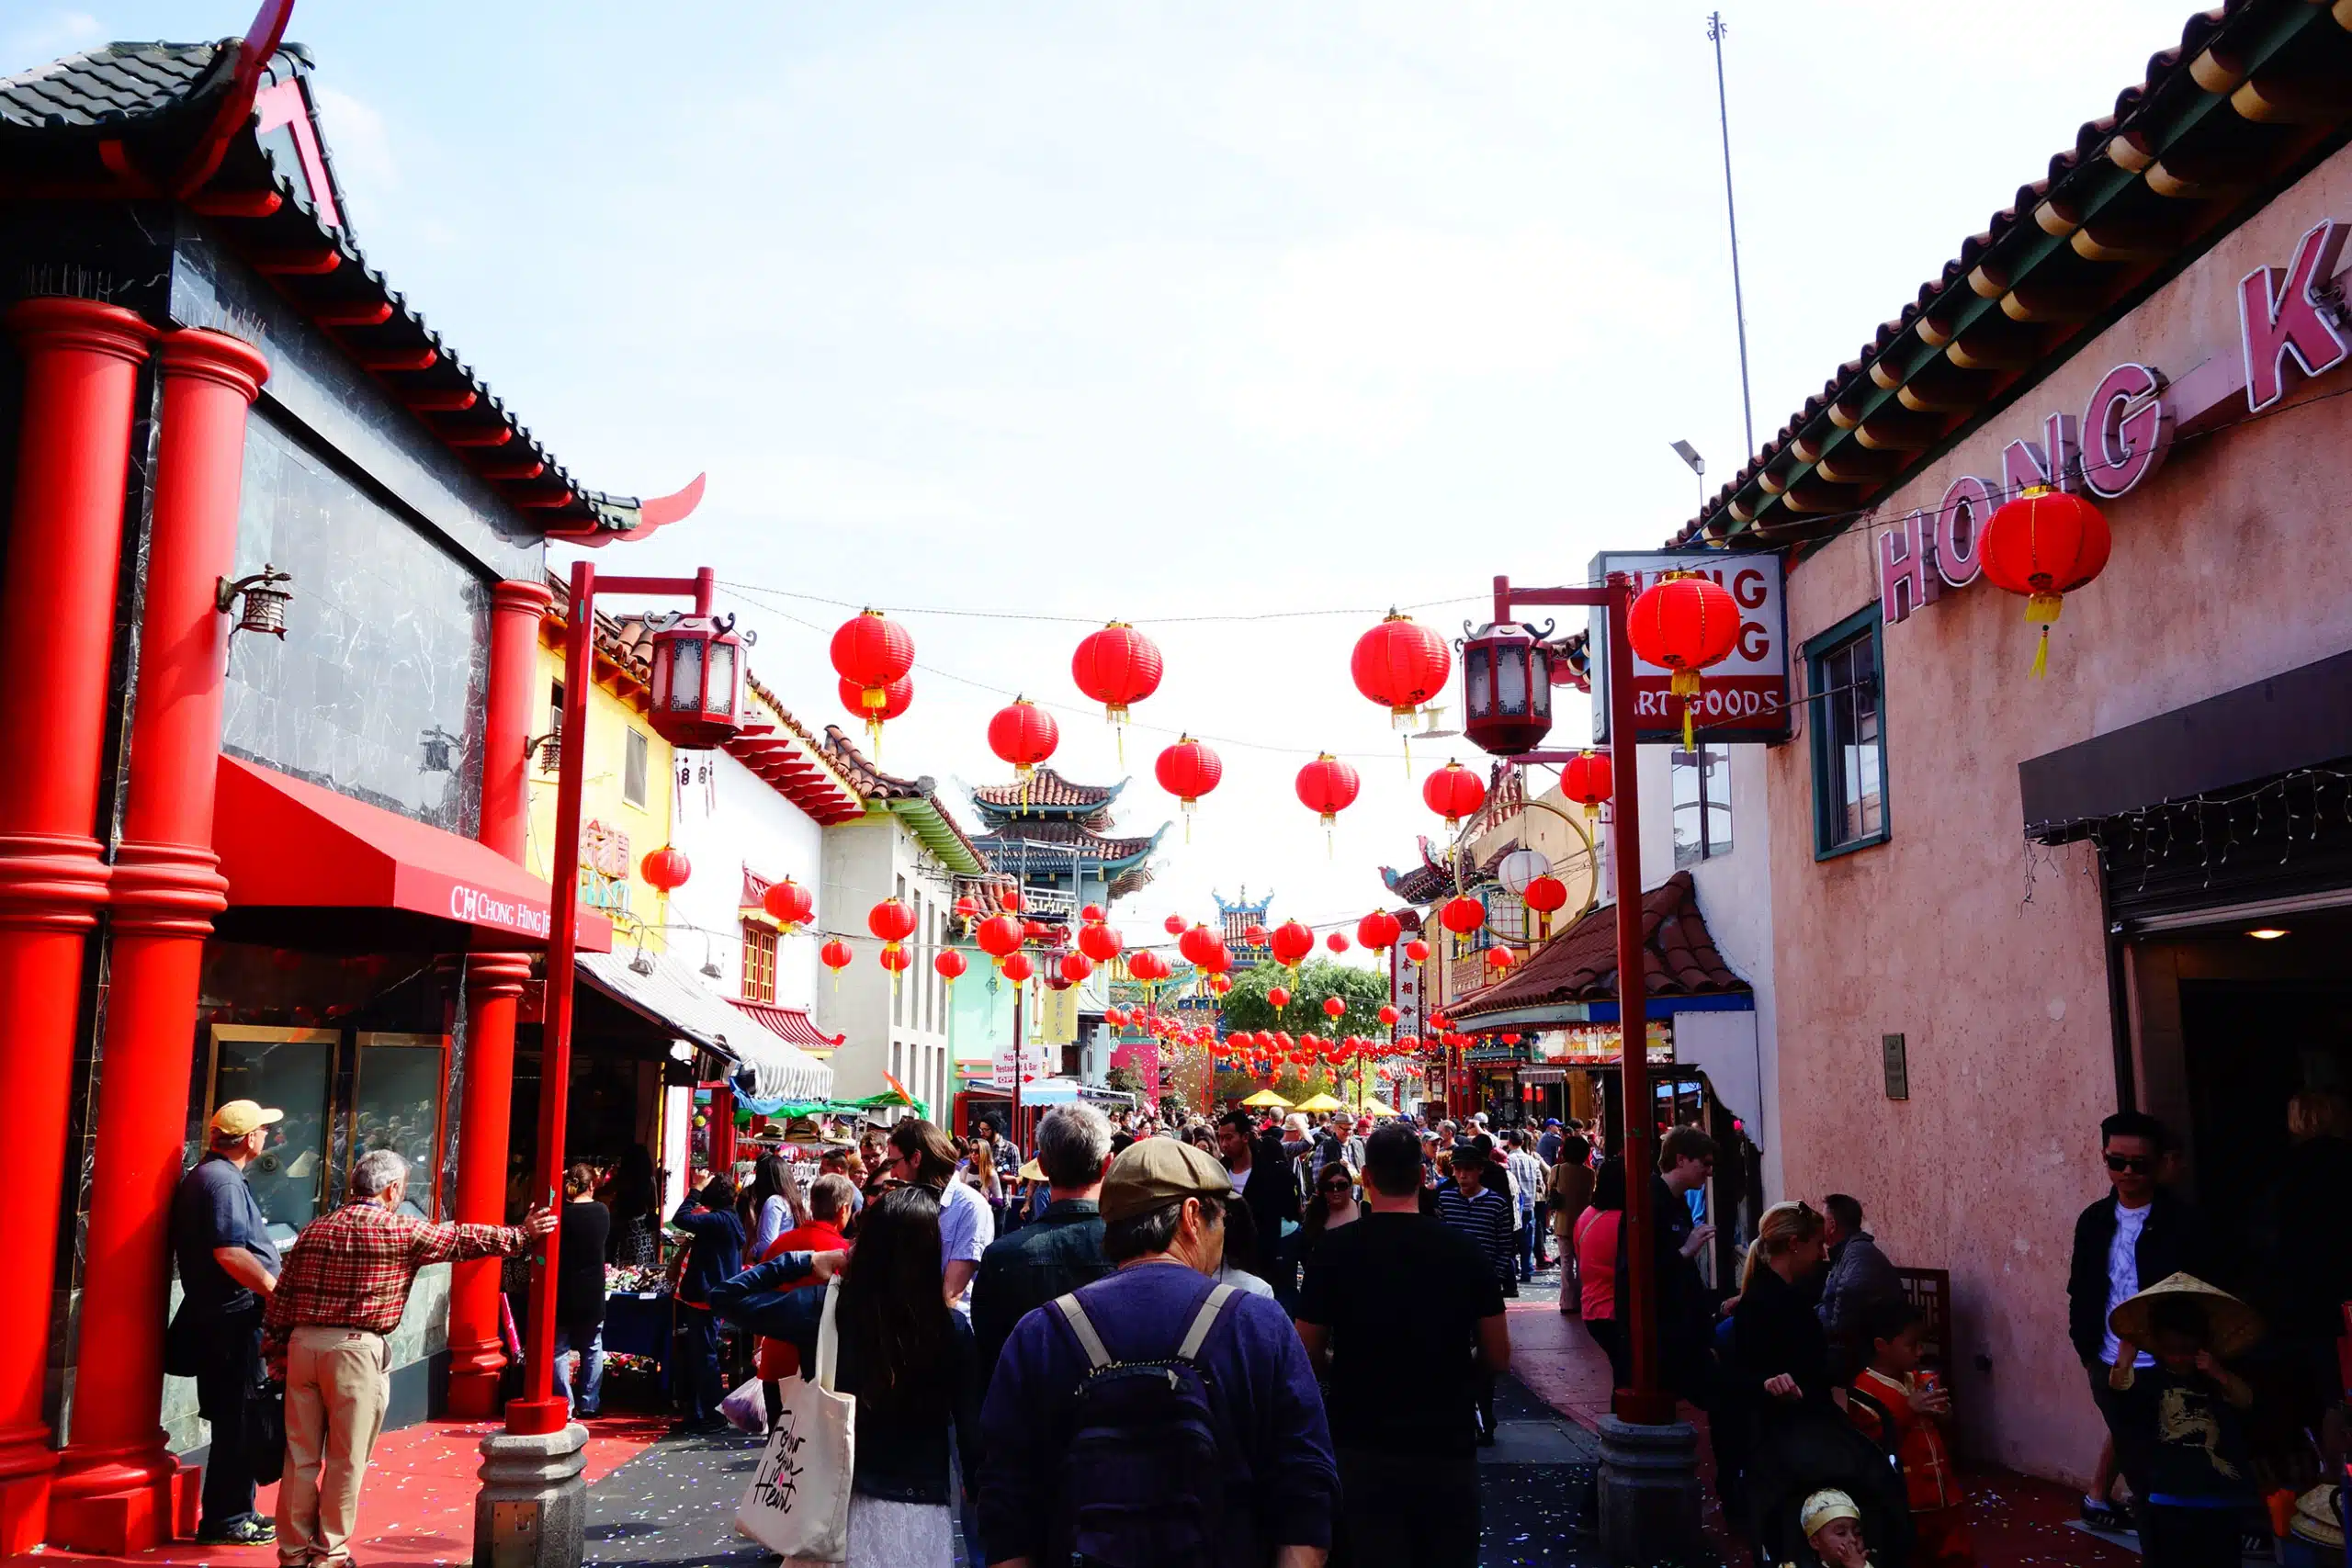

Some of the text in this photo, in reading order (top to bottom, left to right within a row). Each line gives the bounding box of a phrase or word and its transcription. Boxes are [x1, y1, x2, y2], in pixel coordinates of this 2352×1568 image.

[1878, 362, 2163, 628] HONG
[1634, 689, 1779, 716] RT GOODS
[478, 893, 514, 925] CHONG
[517, 904, 541, 932] HING
[996, 1065, 1023, 1073] Restaurt
[753, 1461, 797, 1515] Heart
